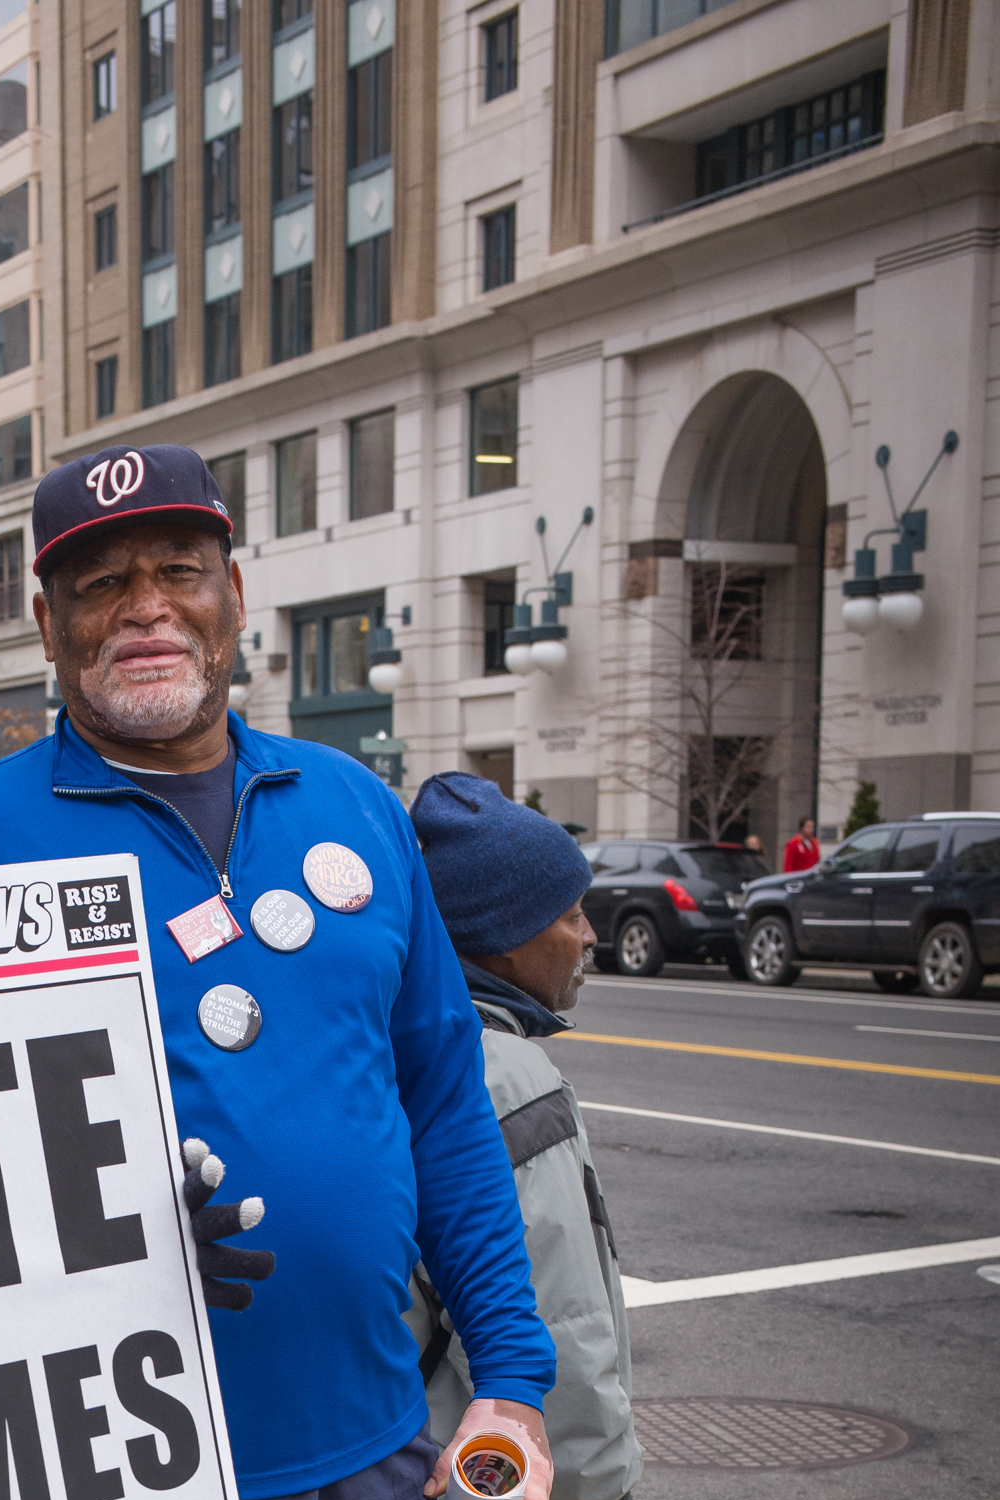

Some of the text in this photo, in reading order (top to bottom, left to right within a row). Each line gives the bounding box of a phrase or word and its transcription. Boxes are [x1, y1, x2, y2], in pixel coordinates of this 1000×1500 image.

[86, 451, 144, 507] W
[64, 883, 121, 907] RISE
[88, 904, 107, 923] &
[179, 902, 217, 925] PROTESTED
[253, 893, 282, 923] IT IS OUR
[260, 901, 287, 929] DUTY TO
[69, 922, 132, 945] RESIST
[177, 924, 191, 935] DAY
[267, 914, 287, 935] FIGHT
[274, 912, 303, 941] FOR OUR
[281, 916, 312, 948] FREEDOM
[207, 1000, 234, 1016] PLACE
[209, 992, 259, 1018] A WOMAN'S
[202, 1017, 246, 1040] STRUGGLE
[204, 1009, 242, 1029] IS IN THE
